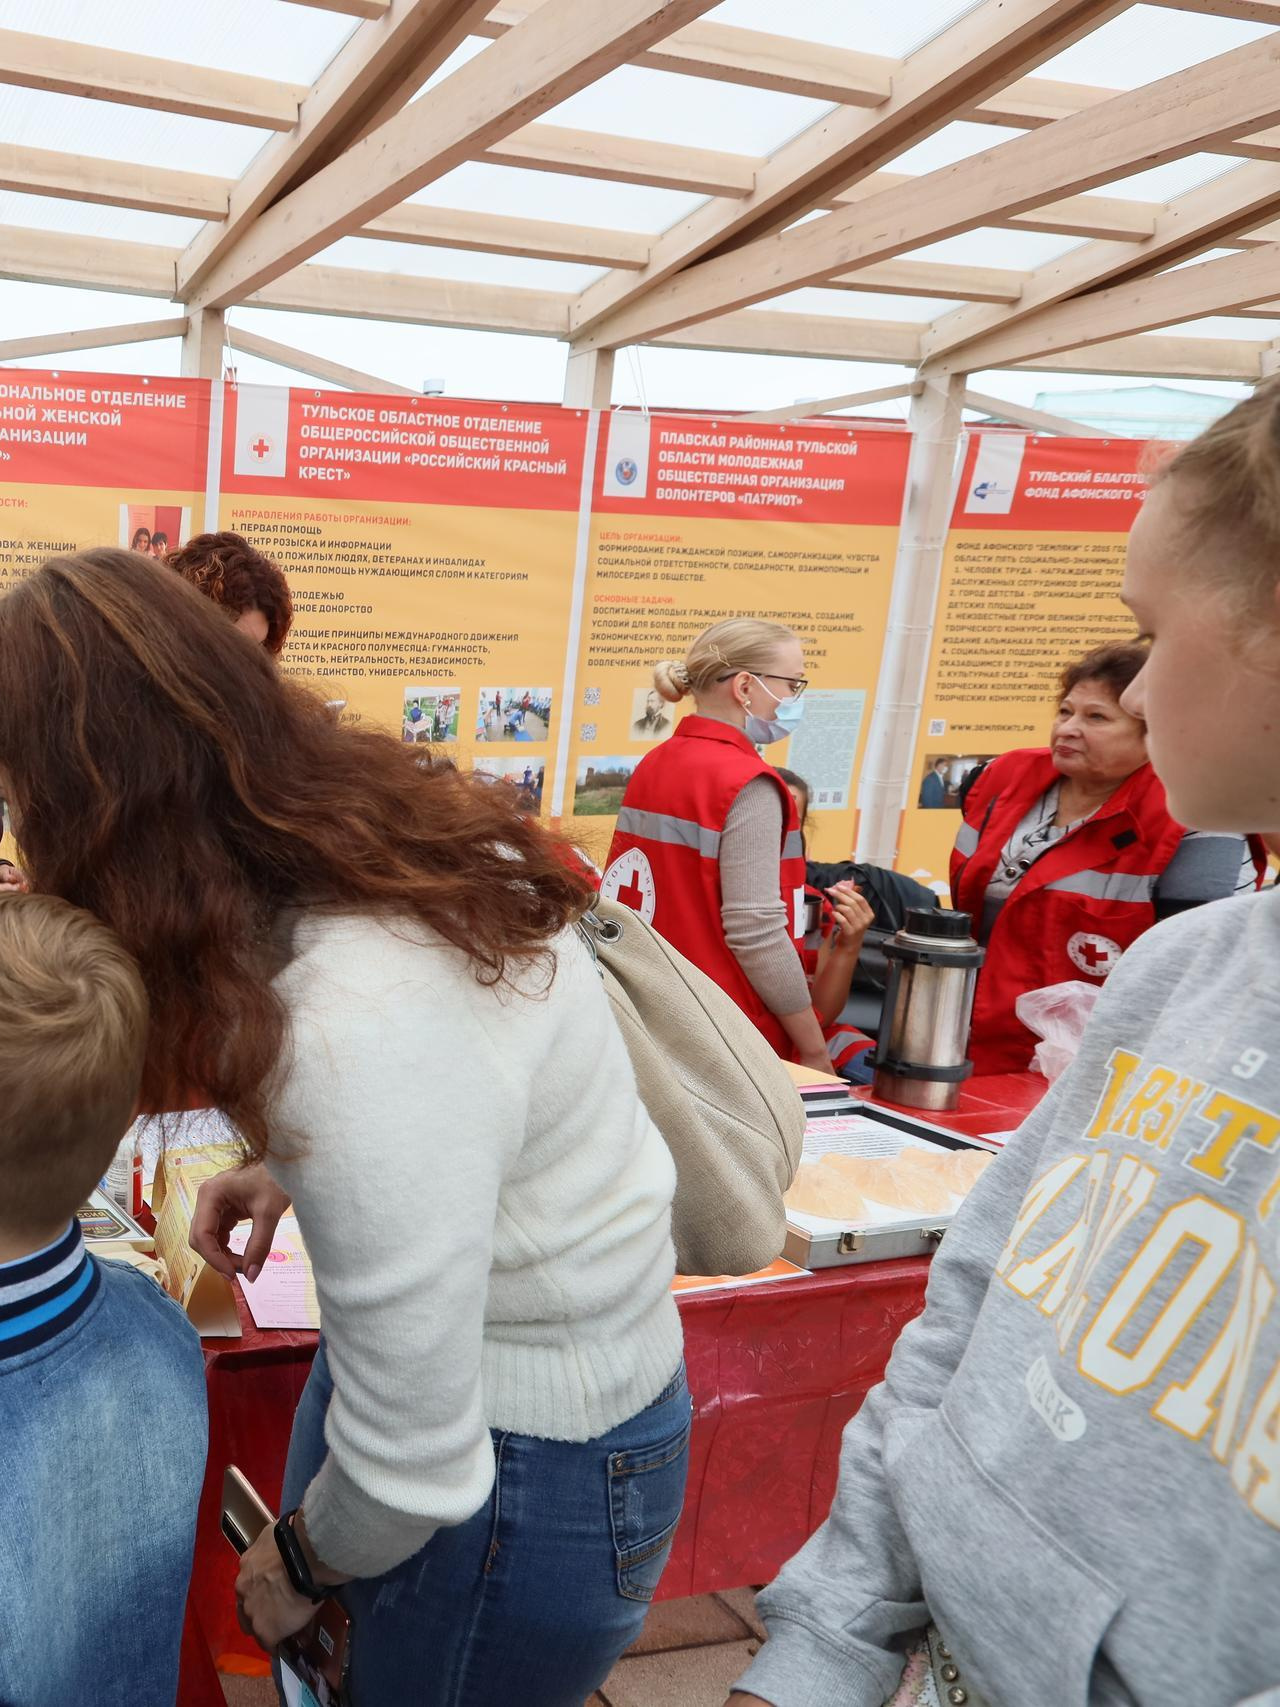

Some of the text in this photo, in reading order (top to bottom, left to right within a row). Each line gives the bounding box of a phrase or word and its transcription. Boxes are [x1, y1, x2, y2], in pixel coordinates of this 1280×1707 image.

[90, 390, 186, 408] ОТДЕЛЕНИЕ
[41, 409, 121, 425] ЖЕНСКОЙ
[301, 404, 541, 433] ТУЛЬСКОЕ ОБЛАСТНОЕ ОТДЕЛЕНИЕ
[301, 425, 549, 453] ОБЩЕРОССИЙСКОЙ ОБЩЕСТВЕННОЙ
[660, 432, 857, 454] ПЛАВСКАЯ РАЙОННАЯ ТУЛЬСКОЙ
[299, 446, 566, 474] ОРГАНИЗАЦИИ «РОССИЙСКИЙ КРАСНЫЙ
[658, 451, 803, 469] ОБЛАСТИ МОЛОДЕЖНАЯ
[298, 466, 350, 480] КРЕСТ»
[657, 469, 844, 490] ОБЩЕСТВЕННАЯ ОРГАНИЗАЦИЯ
[1030, 470, 1092, 482] ТУЛЬСКИЙ
[656, 488, 803, 506] ВОЛОНТЕРОВ «ПАТРИОТ»
[1024, 487, 1132, 499] ФОНД АФОНСКОГО
[231, 509, 302, 520] НАПРАВЛЕНИЯ
[303, 512, 342, 522] РАБОТЫ
[240, 523, 278, 532] ПЕРВАЯ
[279, 525, 322, 535] ПОМОЩЬ
[27, 541, 76, 552] ЖЕНЩИН
[273, 537, 391, 550] РОЗЫСКА ИНФОРМАЦИИ
[285, 551, 333, 561] ПОЖИЛЫХ
[372, 555, 424, 564] ВЕТЕРАНАХ
[432, 557, 485, 567] ИНВАЛИДАХ
[315, 565, 528, 580] ПОМОЩЬ НУЖДАЮЩИМСЯ СЛОЯМ КАТЕГОРИЯМ
[318, 604, 373, 613] ДОНОРСТВО
[331, 630, 518, 641] ПРИНЦИПЫ МЕЖДУНАРОДНОГО ДВИЖЕНИЯ
[320, 642, 366, 651] КРАСНОГО
[1231, 1047, 1268, 1080] 9
